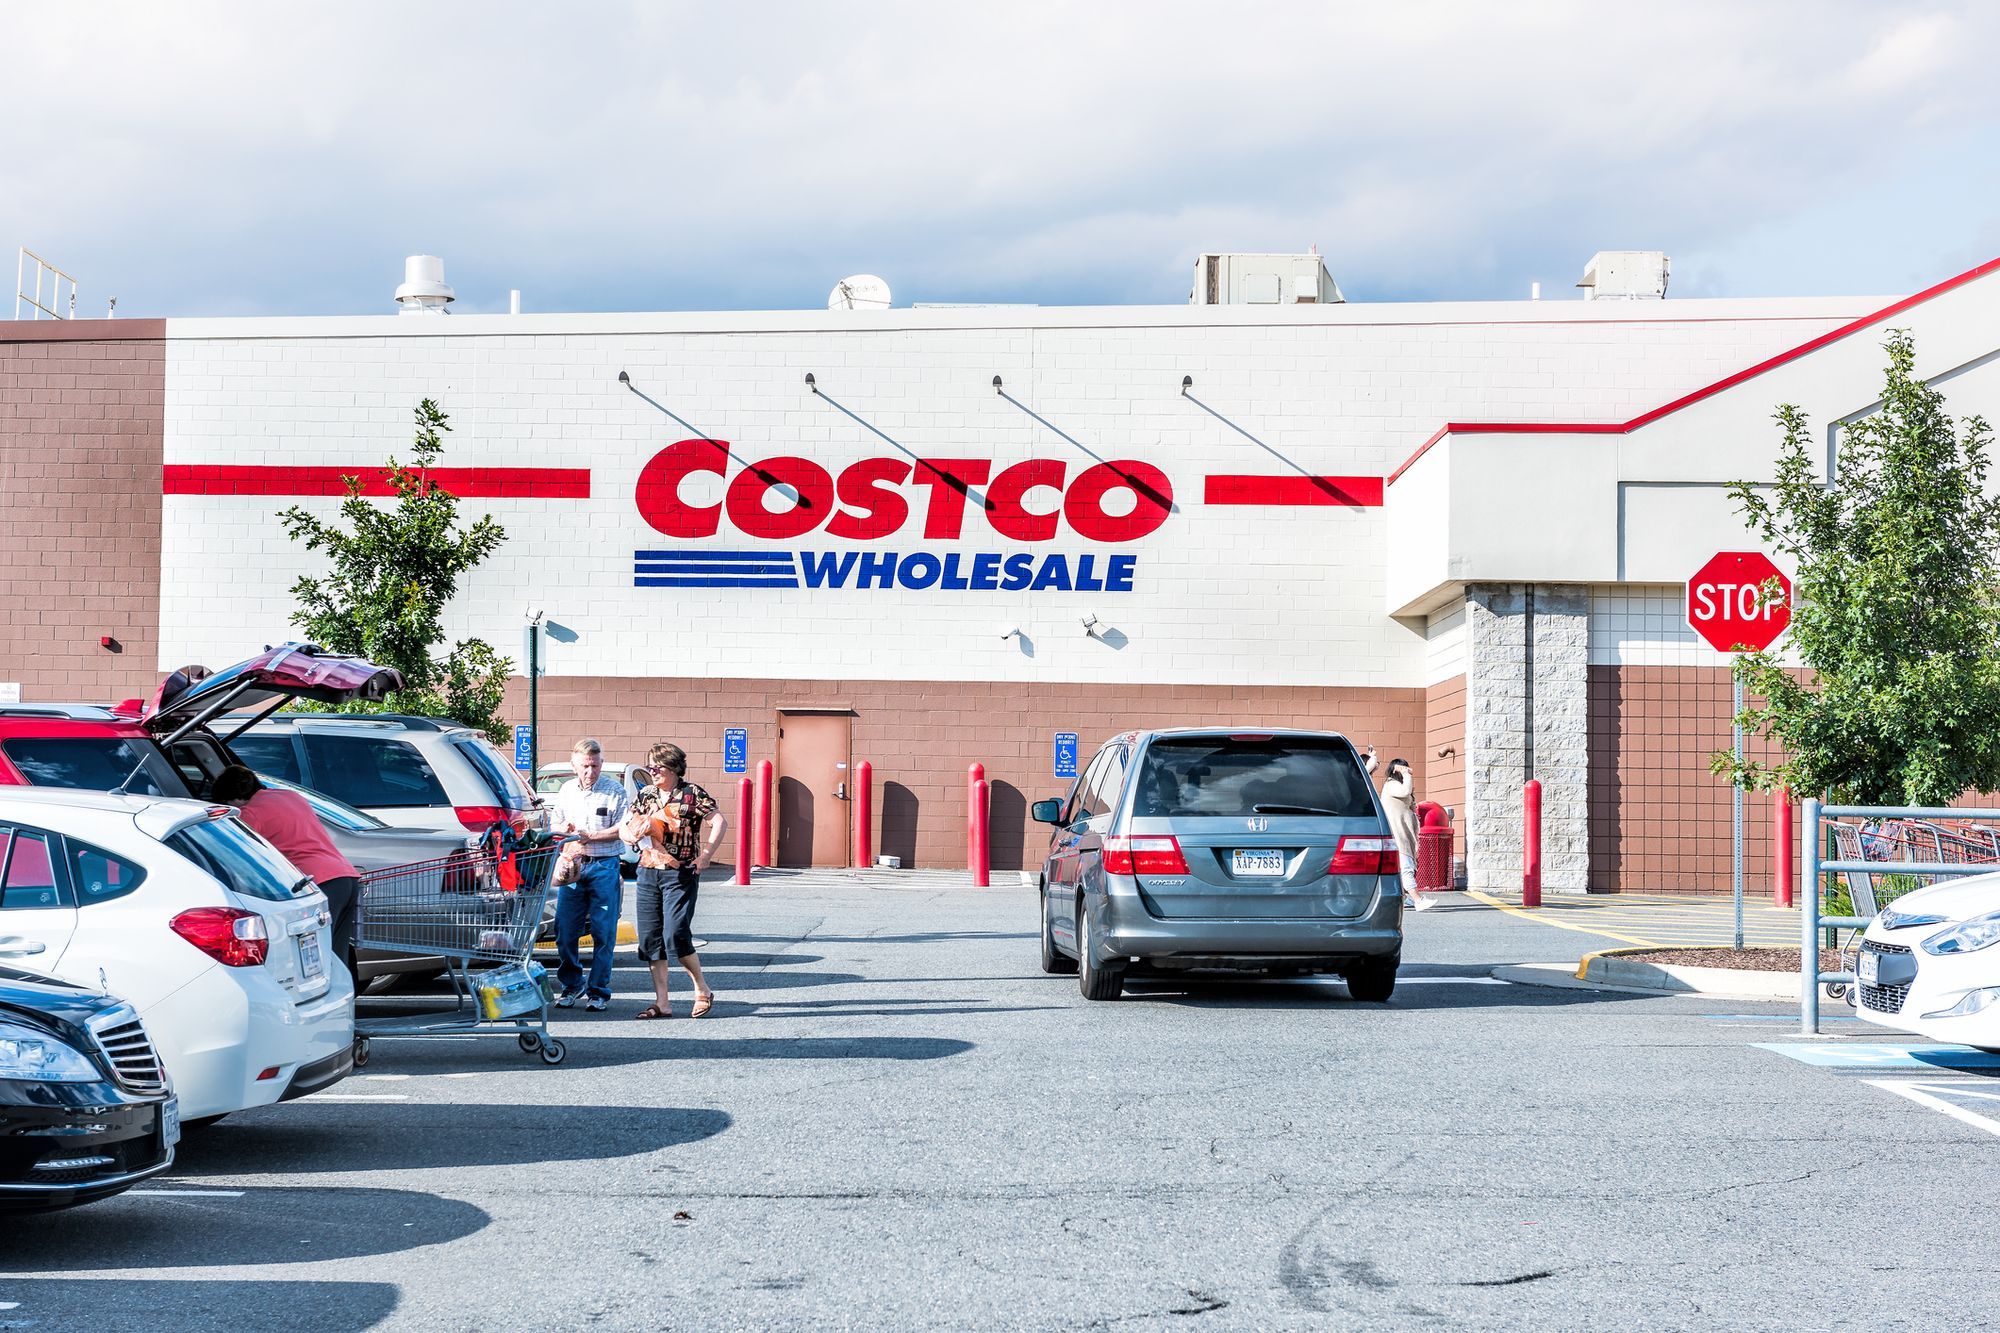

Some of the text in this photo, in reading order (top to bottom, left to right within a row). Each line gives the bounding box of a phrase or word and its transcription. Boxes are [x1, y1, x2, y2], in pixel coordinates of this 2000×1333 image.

[635, 438, 1174, 542] COSTCO
[799, 551, 1138, 592] WHOLESALE
[1694, 583, 1786, 621] STOP
[1236, 856, 1281, 869] XAP-7883
